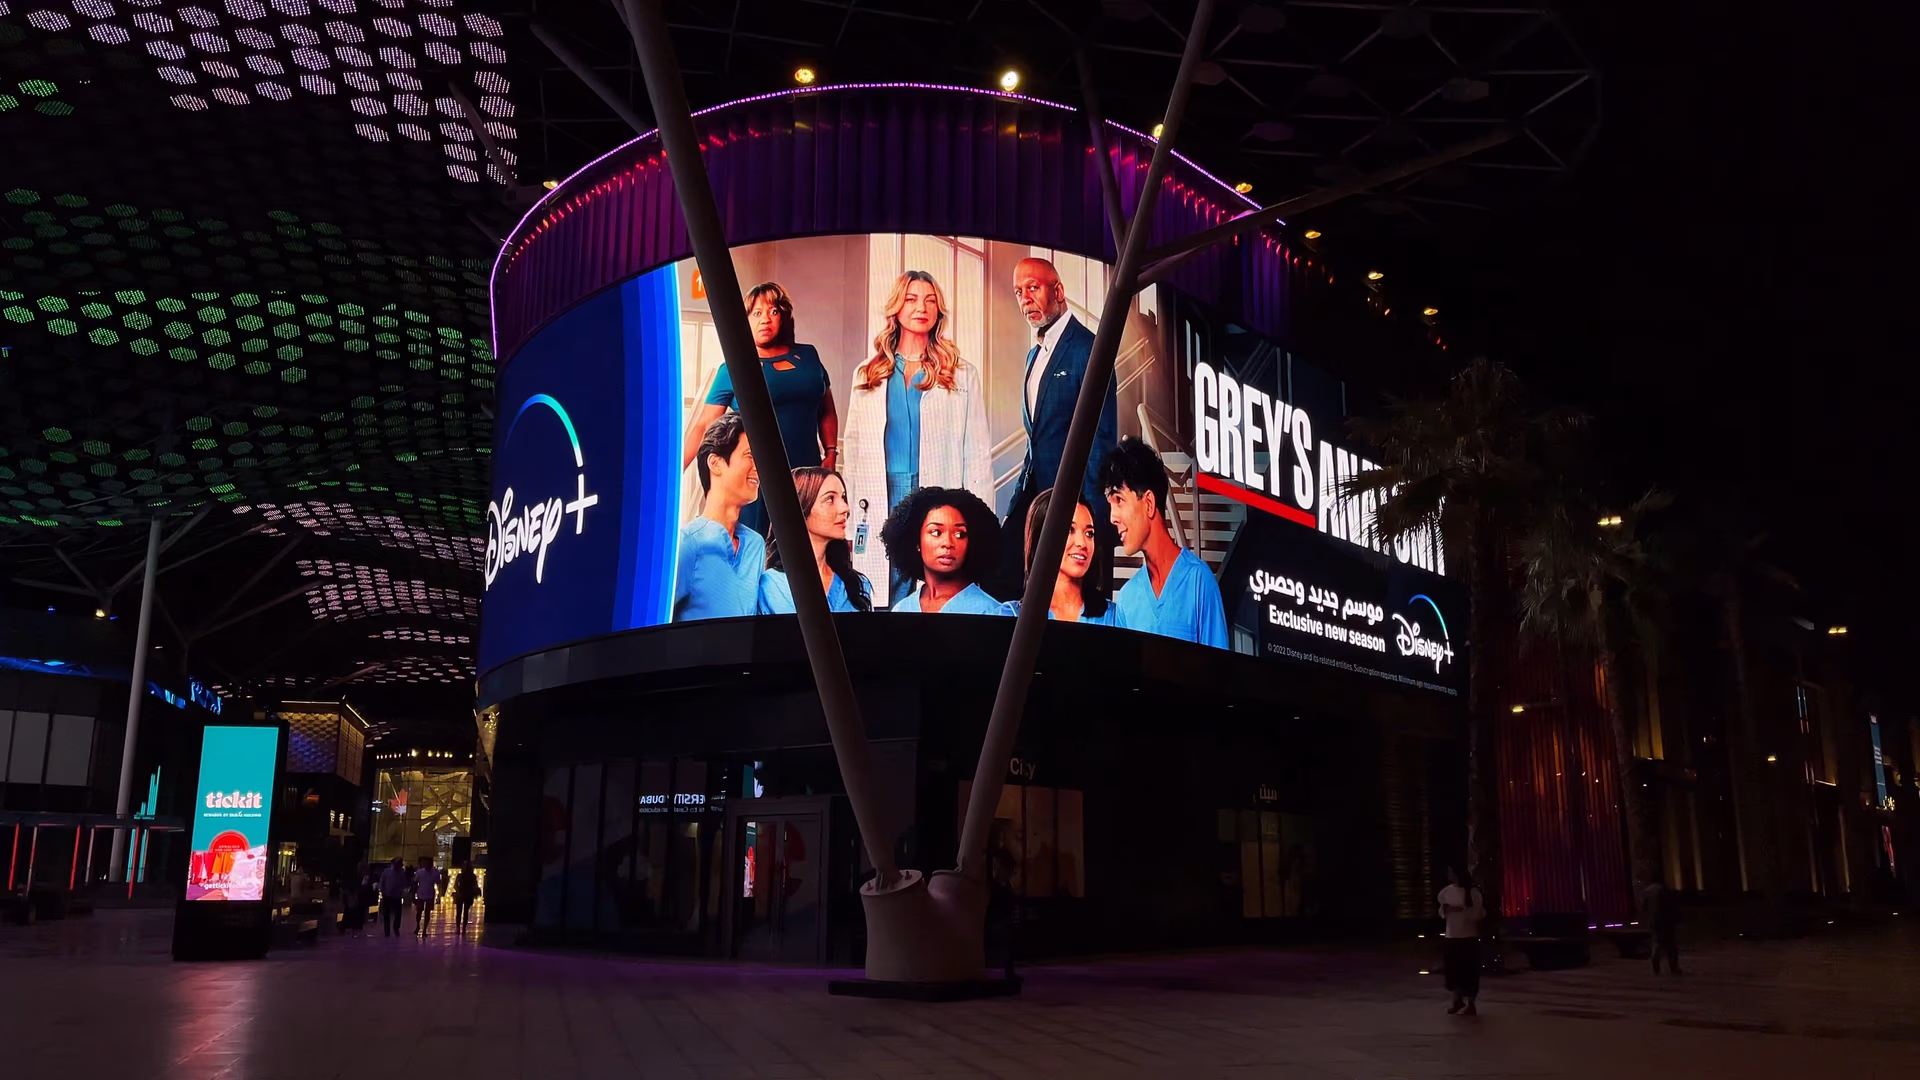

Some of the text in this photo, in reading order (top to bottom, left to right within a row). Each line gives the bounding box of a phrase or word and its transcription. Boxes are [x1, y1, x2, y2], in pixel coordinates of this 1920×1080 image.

[1194, 362, 1446, 577] GREY'S ANAMY
[1250, 569, 1384, 626] موسم جديد وحصري
[1268, 604, 1386, 653] Exclusive new season
[1273, 644, 1286, 656] 2022
[1286, 648, 1303, 660] Disney
[1303, 652, 1312, 662] and
[1319, 656, 1336, 666] related
[205, 791, 262, 809] tickit
